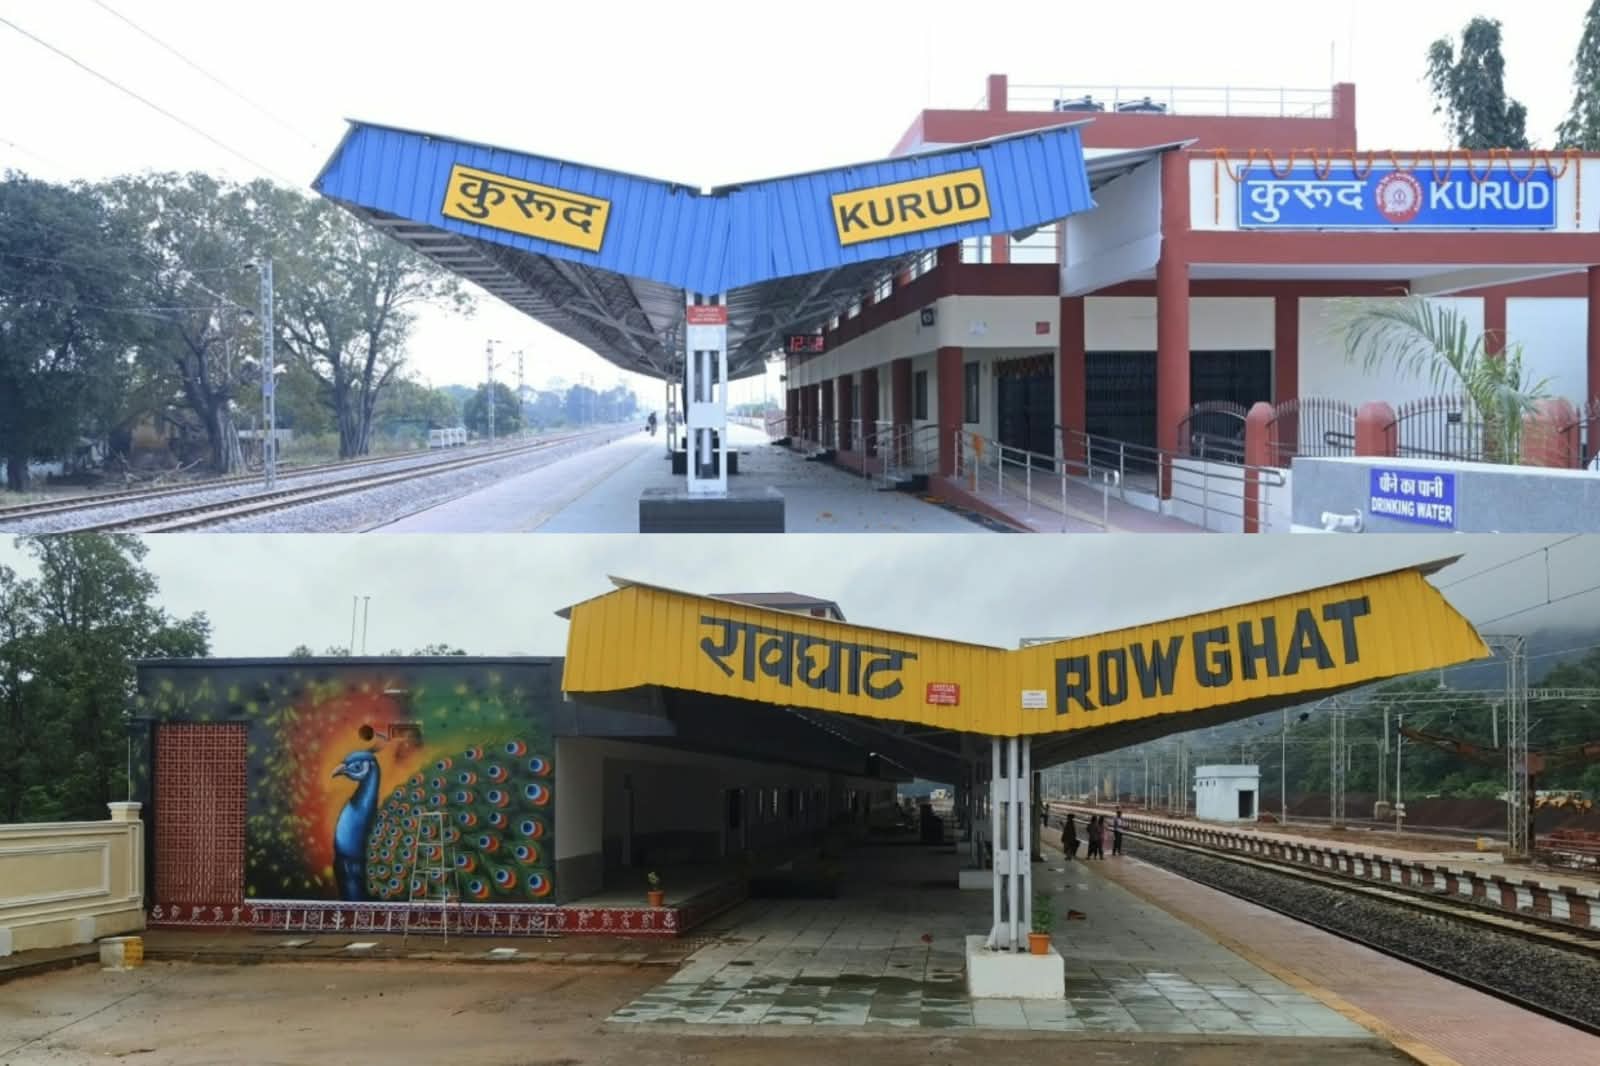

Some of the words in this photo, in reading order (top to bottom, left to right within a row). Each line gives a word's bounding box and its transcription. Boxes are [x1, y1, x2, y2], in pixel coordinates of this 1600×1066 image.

[457, 173, 602, 233] कुरूद
[840, 182, 981, 232] KURUD
[1248, 180, 1367, 222] कुरूद
[1429, 181, 1550, 209] KURUD
[1400, 478, 1415, 495] का
[1418, 476, 1443, 498] पानी
[1371, 496, 1414, 516] DRINKING
[1416, 502, 1452, 523] WATER
[701, 615, 918, 700] रावघाट
